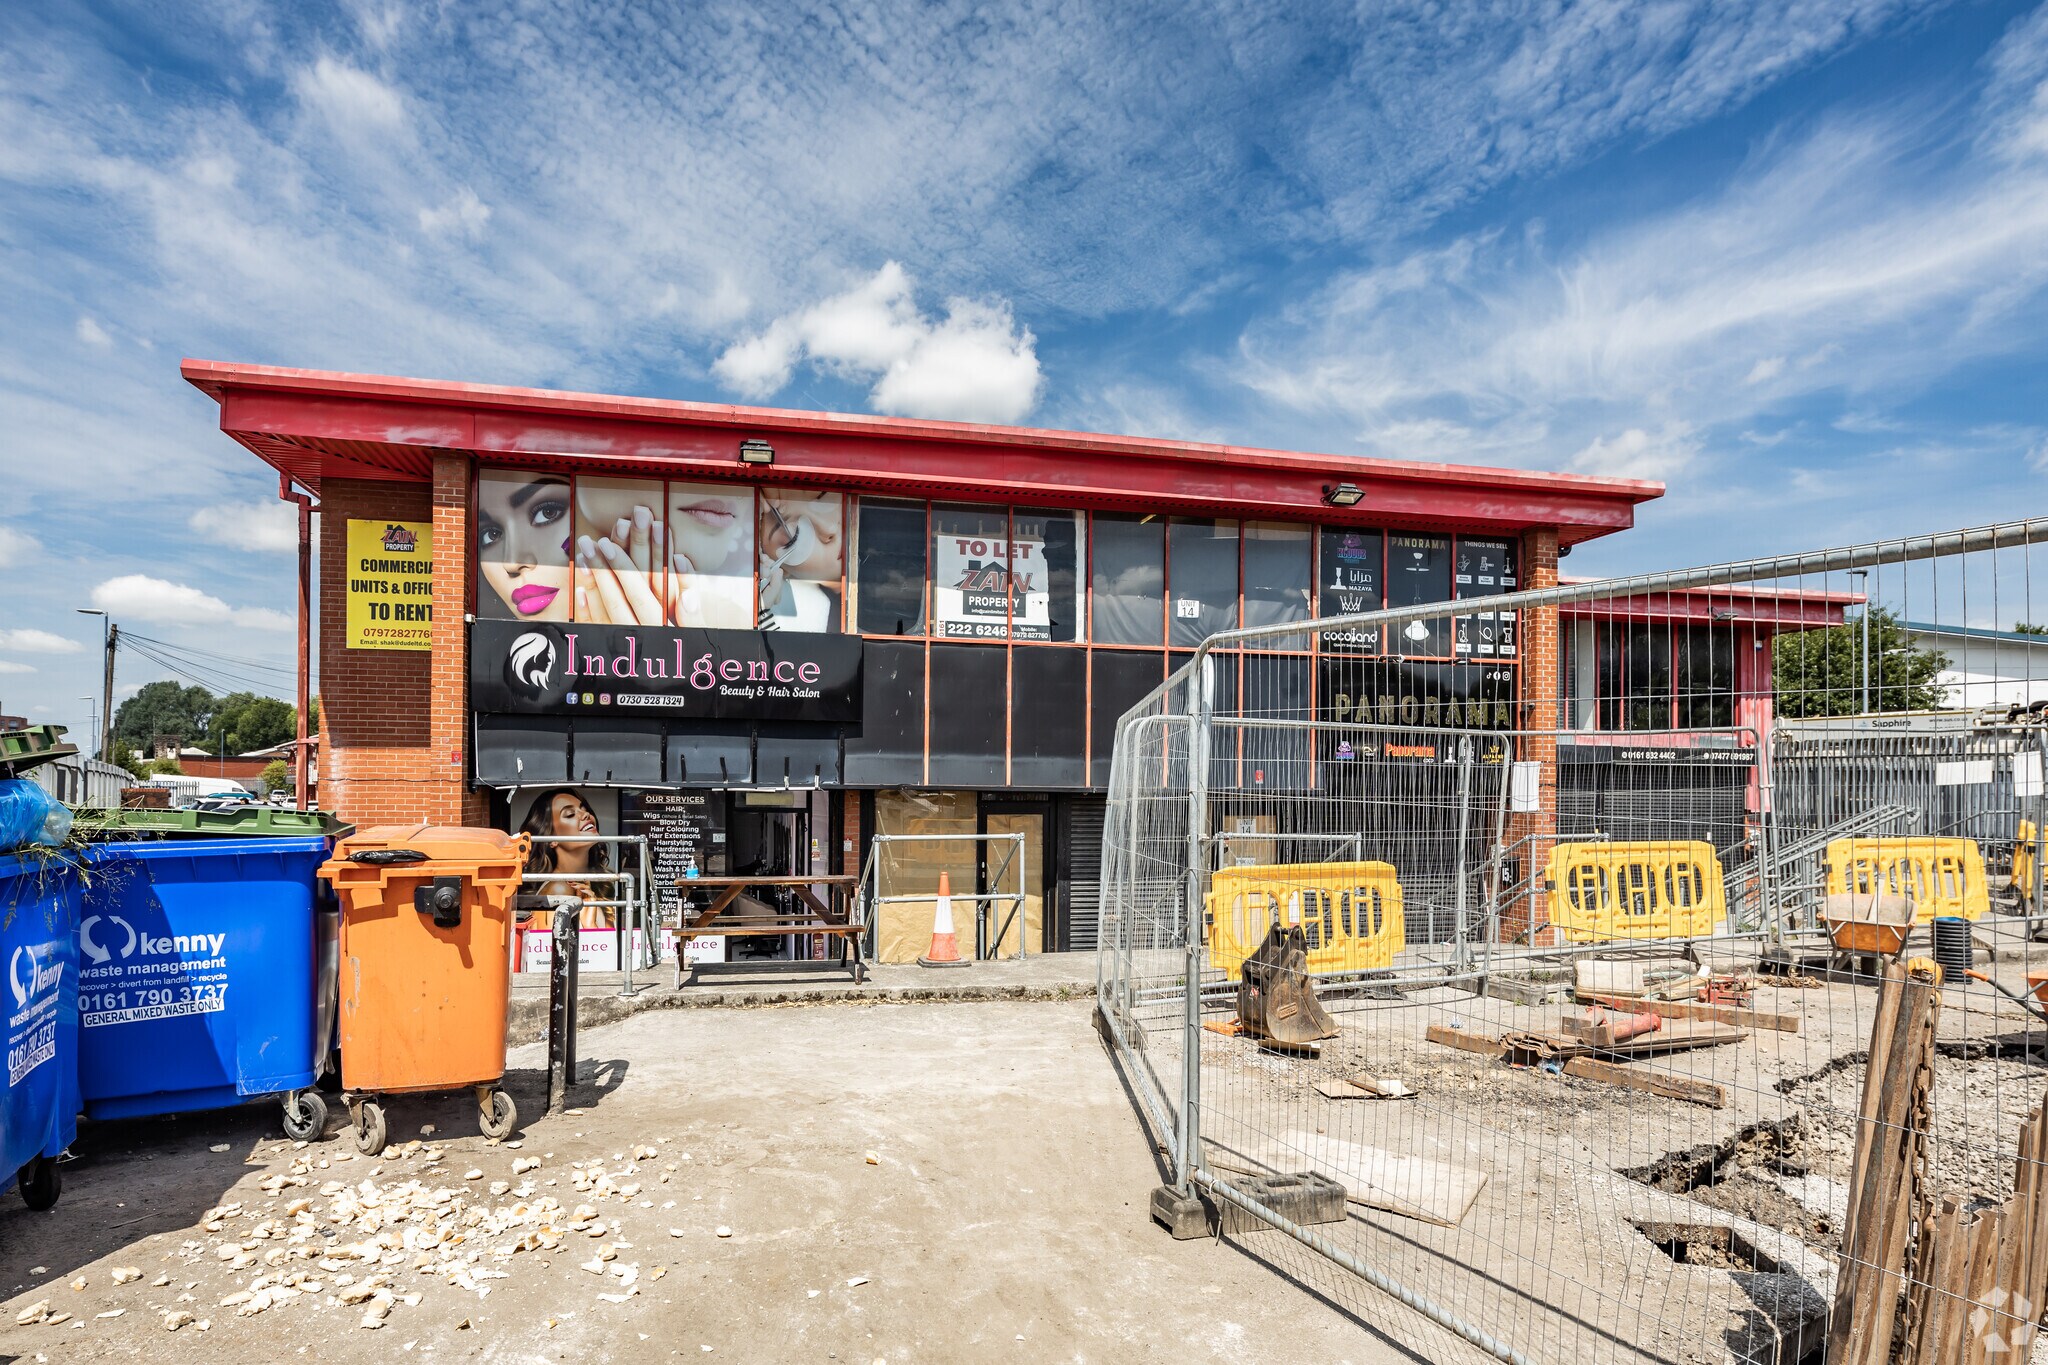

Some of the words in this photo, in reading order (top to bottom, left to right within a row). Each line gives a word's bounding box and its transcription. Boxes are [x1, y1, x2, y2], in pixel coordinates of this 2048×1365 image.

[382, 529, 418, 544] ZAIN
[1391, 537, 1446, 550] PANORAMA
[1464, 540, 1486, 548] THINGS
[385, 543, 414, 551] PROPERTY
[956, 539, 988, 557] TO
[993, 542, 1033, 559] LET
[360, 558, 433, 575] COMMERCIA
[351, 579, 389, 594] UNITS
[391, 582, 401, 595] &
[957, 568, 1034, 594] ZAIN
[368, 602, 390, 621] TO
[394, 603, 433, 622] RENT
[1182, 607, 1194, 617] 14
[363, 628, 433, 639] 0797282776
[947, 623, 973, 635] 222
[975, 625, 1008, 637] 6246
[564, 633, 821, 691] Indulgence
[719, 685, 755, 699] Beauty
[756, 687, 764, 697] &
[767, 686, 790, 698] Hair
[792, 687, 821, 699] Salon
[619, 695, 642, 705] 0730
[643, 697, 661, 706] 528
[662, 697, 683, 707] 1324
[1335, 693, 1511, 726] PANORAMA
[1871, 718, 1912, 729] Sapphire
[1385, 743, 1435, 758] Panorama
[645, 795, 664, 803] OUR
[665, 795, 705, 804] SERVICES
[643, 812, 661, 820] Wigs
[678, 819, 691, 827] Dry
[658, 902, 677, 910] crylic
[140, 931, 226, 957] kenny
[78, 964, 123, 979] waste
[127, 956, 227, 975] management
[36, 961, 65, 993] kenny
[78, 982, 109, 992] recover
[118, 979, 141, 989] divert
[143, 978, 162, 987] from
[163, 975, 190, 985] landfill
[198, 973, 228, 982] recycle
[77, 991, 127, 1012] 0161
[135, 988, 173, 1007] 790
[179, 983, 229, 1004] 3737
[9, 1008, 30, 1029] waste
[85, 1011, 131, 1026] GENERAL
[132, 1007, 163, 1021] MIXED
[164, 1002, 196, 1016] WASTE
[197, 998, 222, 1012] ONLY
[8, 1041, 27, 1071] 0161
[38, 1020, 56, 1047] 3737
